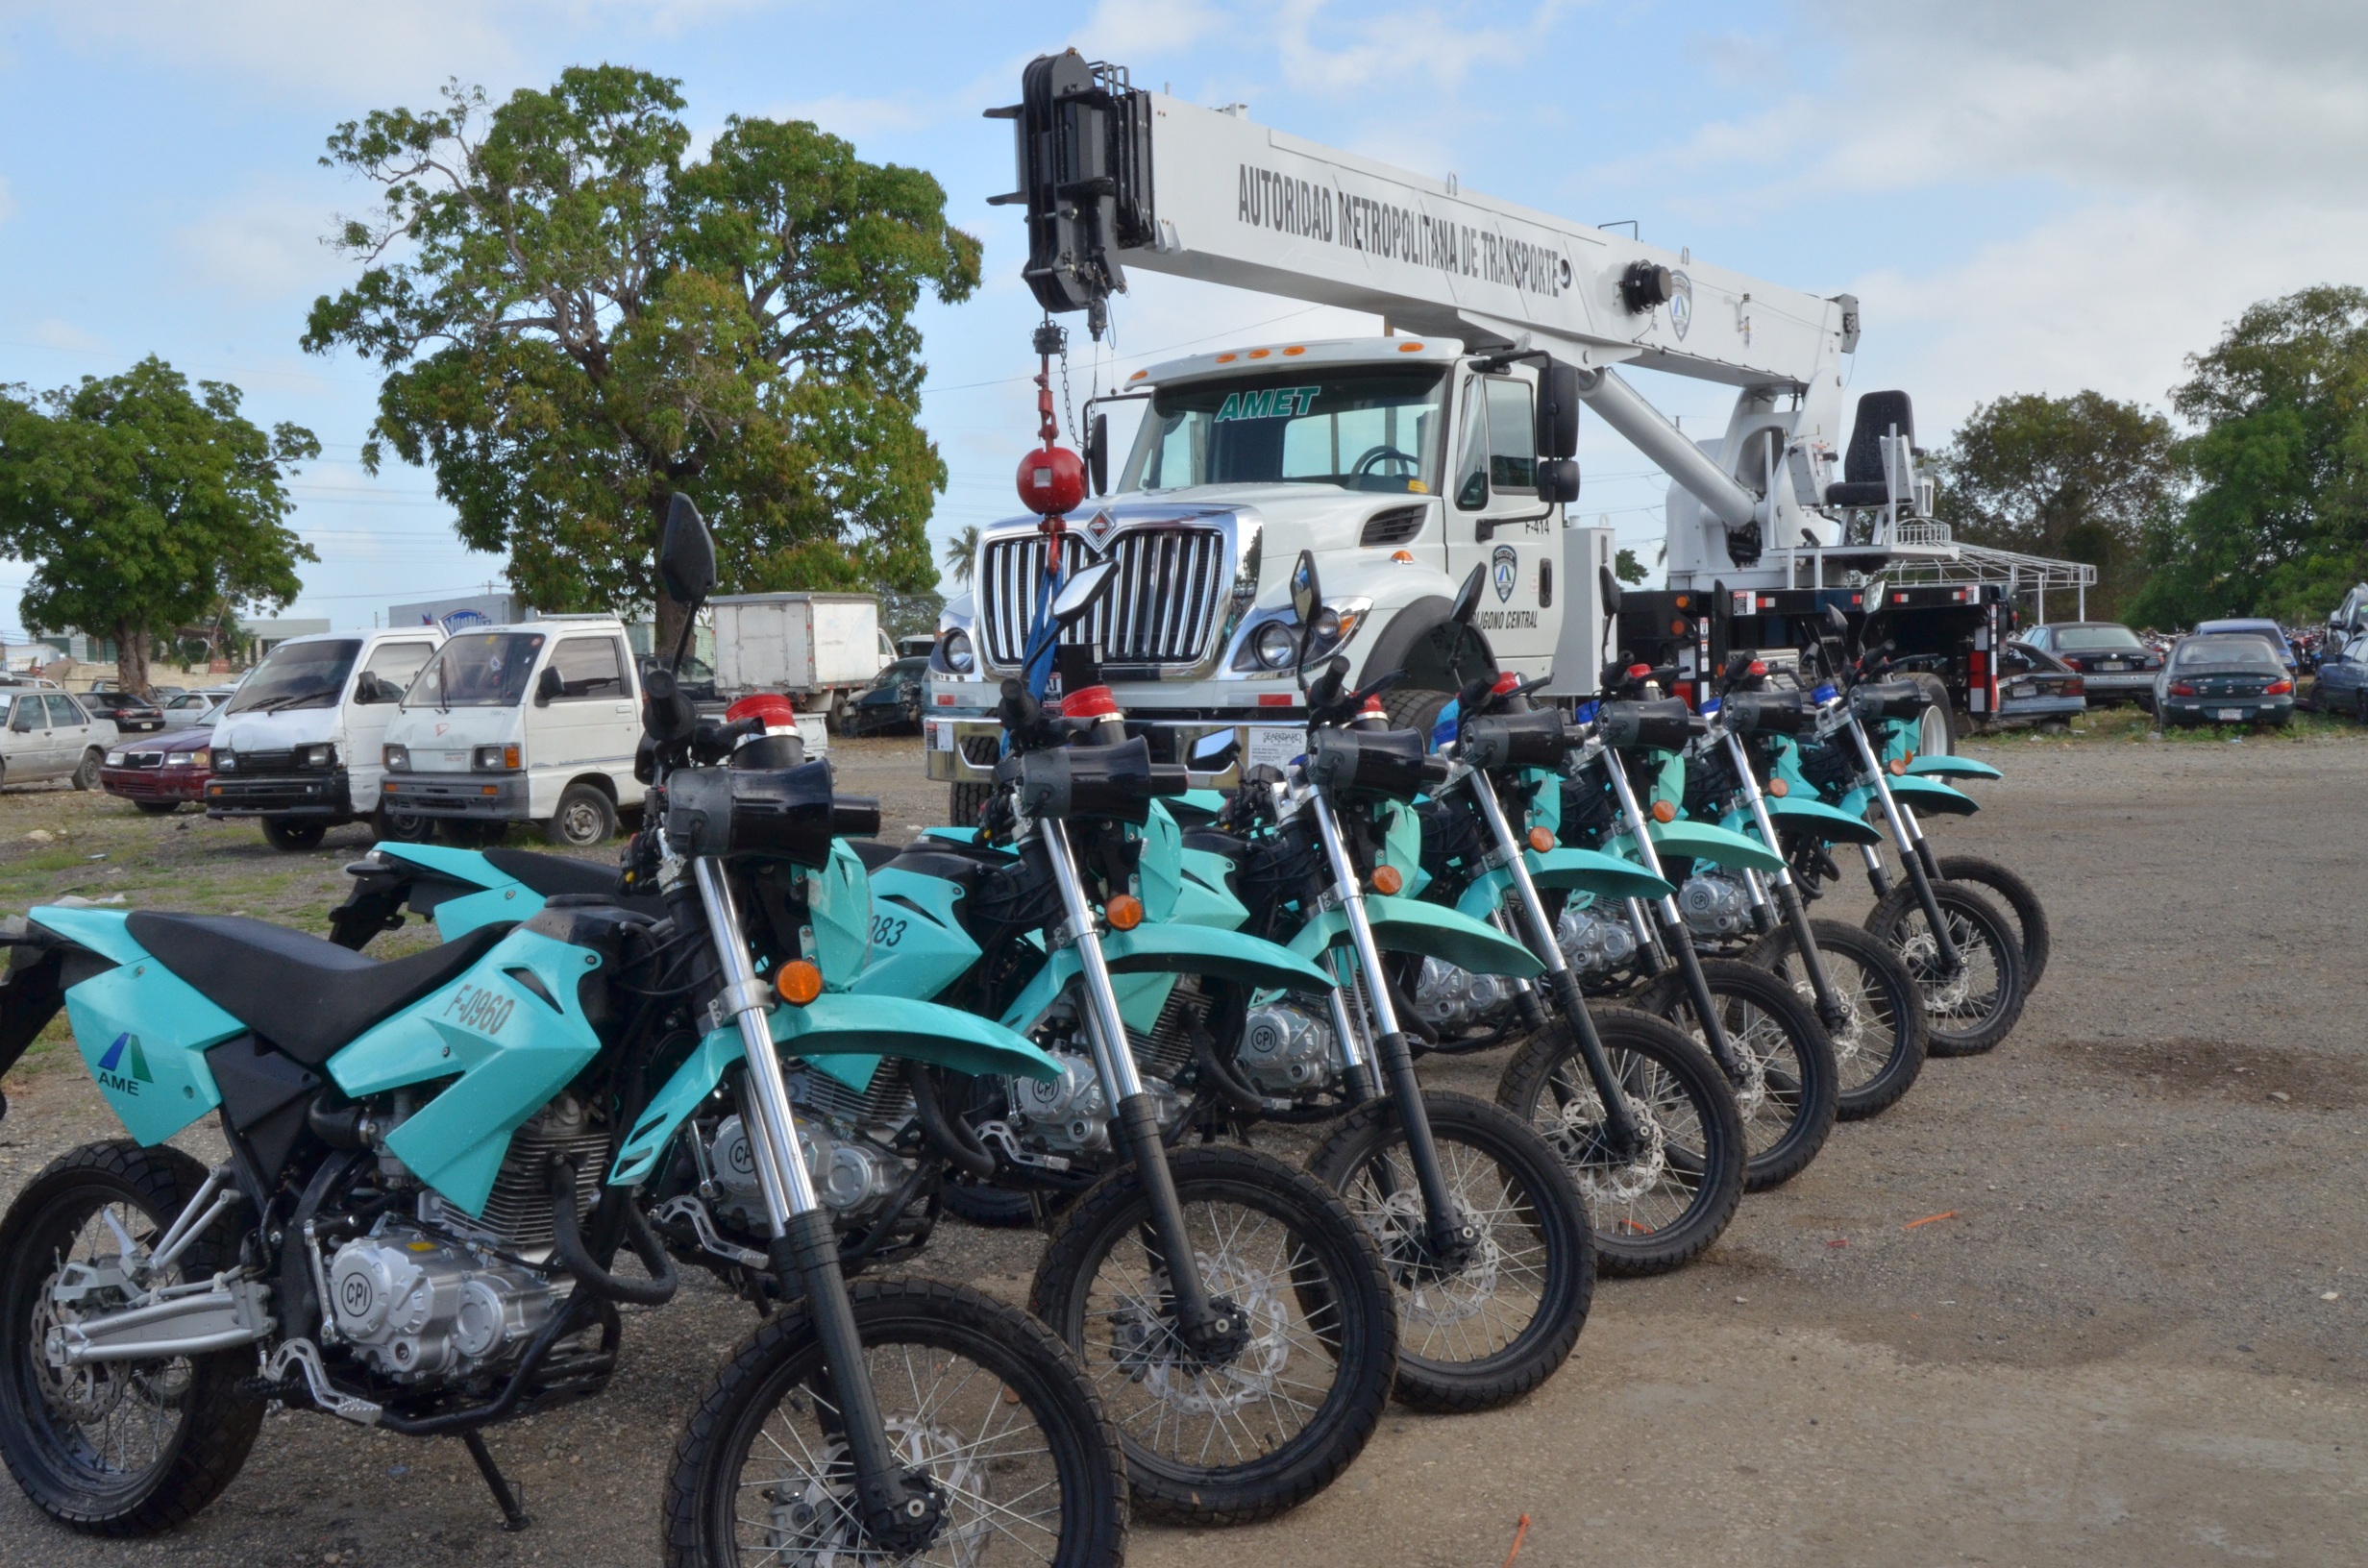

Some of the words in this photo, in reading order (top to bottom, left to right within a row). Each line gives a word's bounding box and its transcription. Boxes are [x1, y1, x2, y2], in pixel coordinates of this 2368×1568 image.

[1239, 163, 1333, 243] AUTORIDAD
[1338, 190, 1458, 274] METROPOLITANA
[1462, 225, 1478, 279] DE
[1481, 232, 1559, 297] TRANSPORTE
[1214, 386, 1321, 423] AMET
[1506, 610, 1538, 629] CENTRAL
[443, 983, 515, 1035] F-0960
[1255, 1031, 1273, 1046] CPI
[98, 1071, 139, 1096] AME
[1036, 1080, 1055, 1097] CPI
[346, 1283, 367, 1308] CPI
